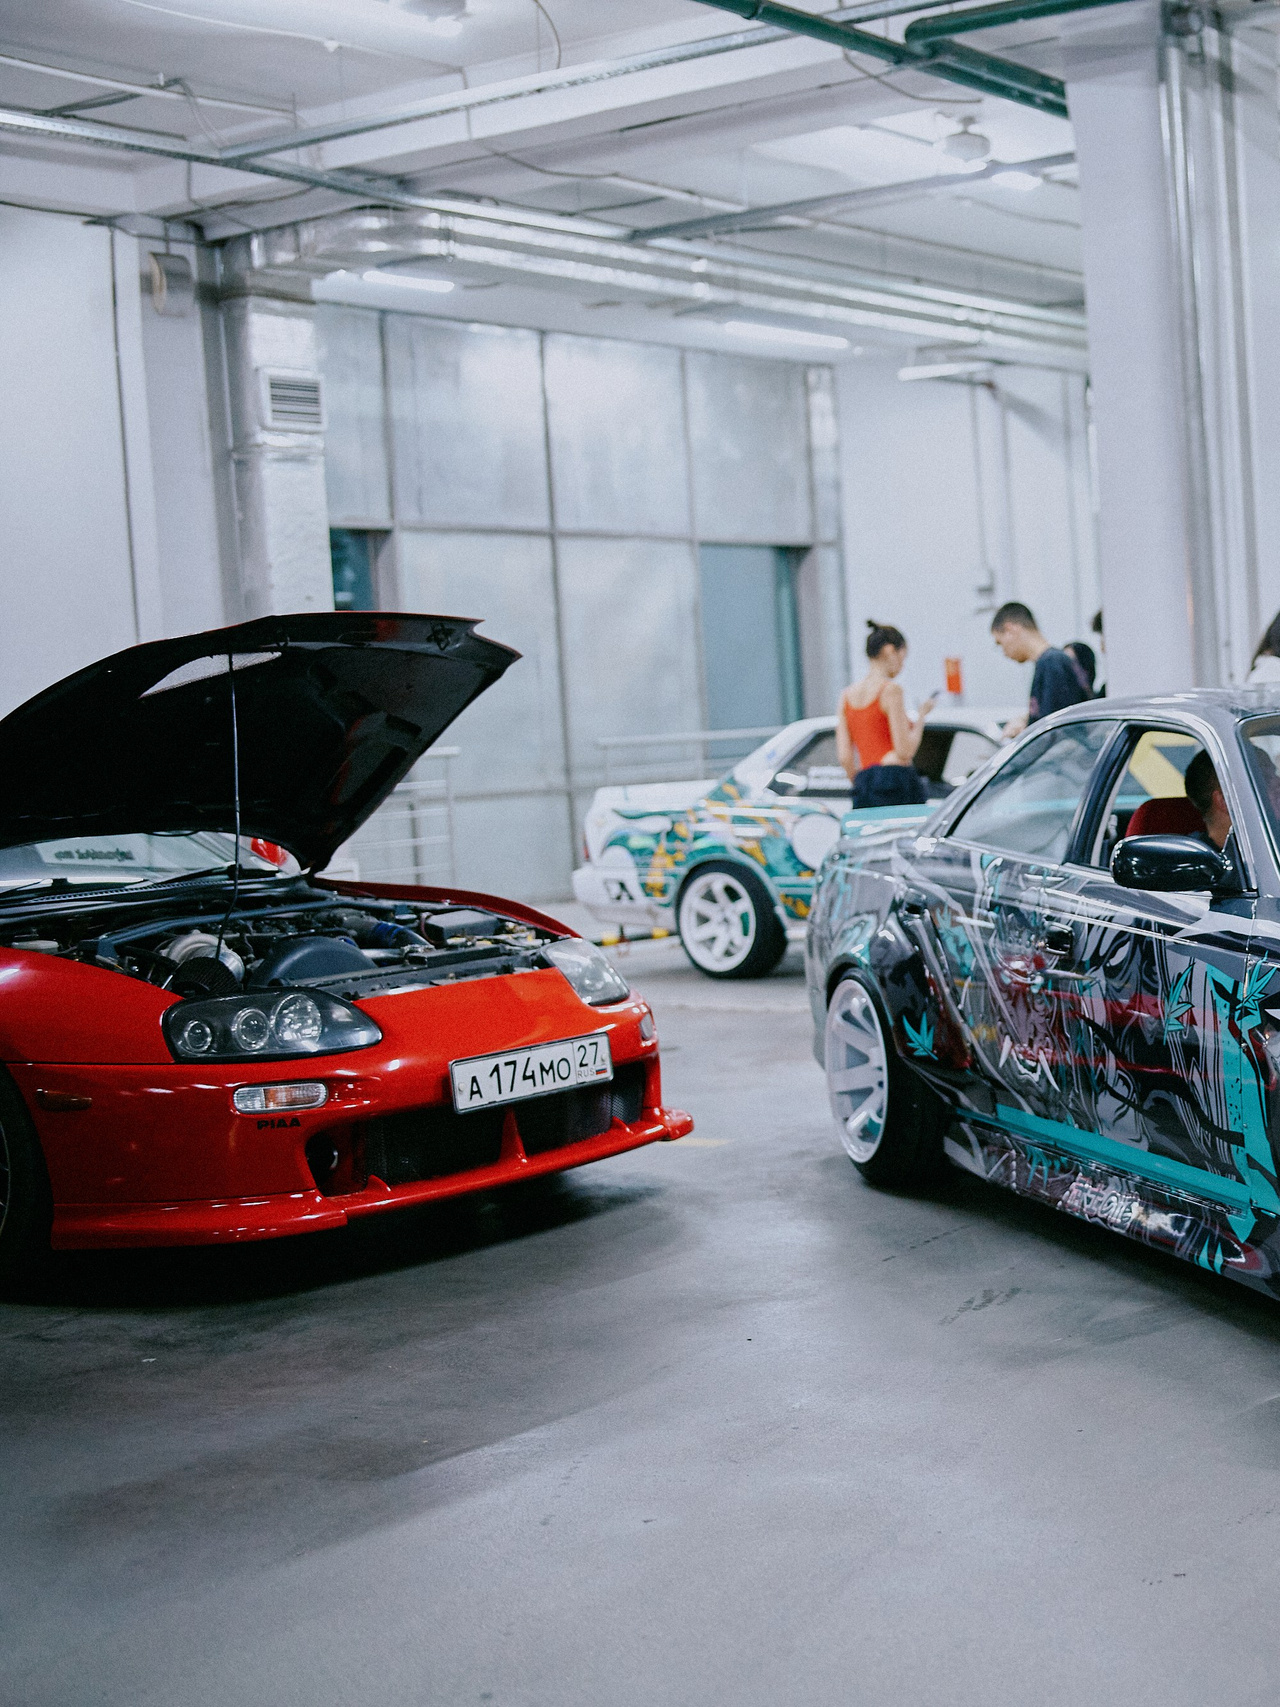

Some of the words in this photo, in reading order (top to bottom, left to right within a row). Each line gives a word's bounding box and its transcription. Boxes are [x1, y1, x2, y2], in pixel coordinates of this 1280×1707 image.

[577, 1042, 599, 1068] 27
[577, 1068, 595, 1079] RUS
[257, 1117, 301, 1130] PIAA
